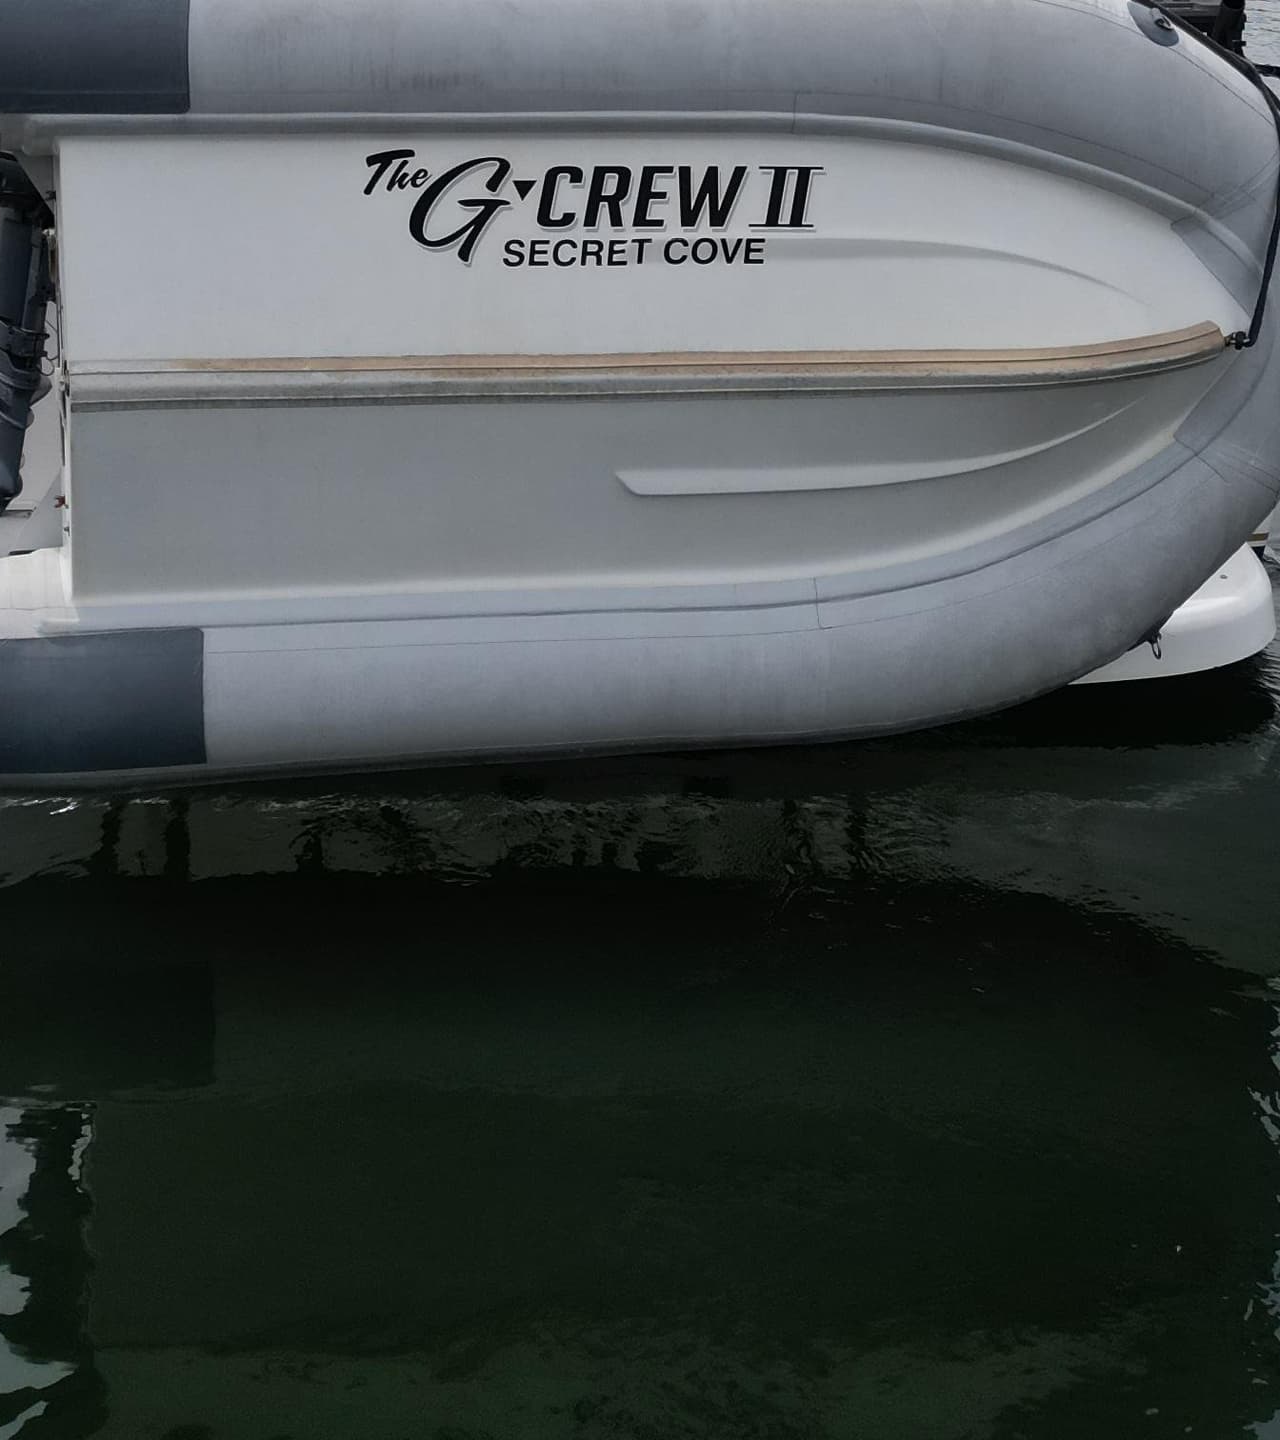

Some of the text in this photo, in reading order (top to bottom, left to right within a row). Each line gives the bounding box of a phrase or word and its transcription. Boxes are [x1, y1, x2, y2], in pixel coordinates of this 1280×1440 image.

[363, 148, 431, 196] The
[748, 165, 826, 230] II
[502, 238, 765, 267] SECRET COVE
